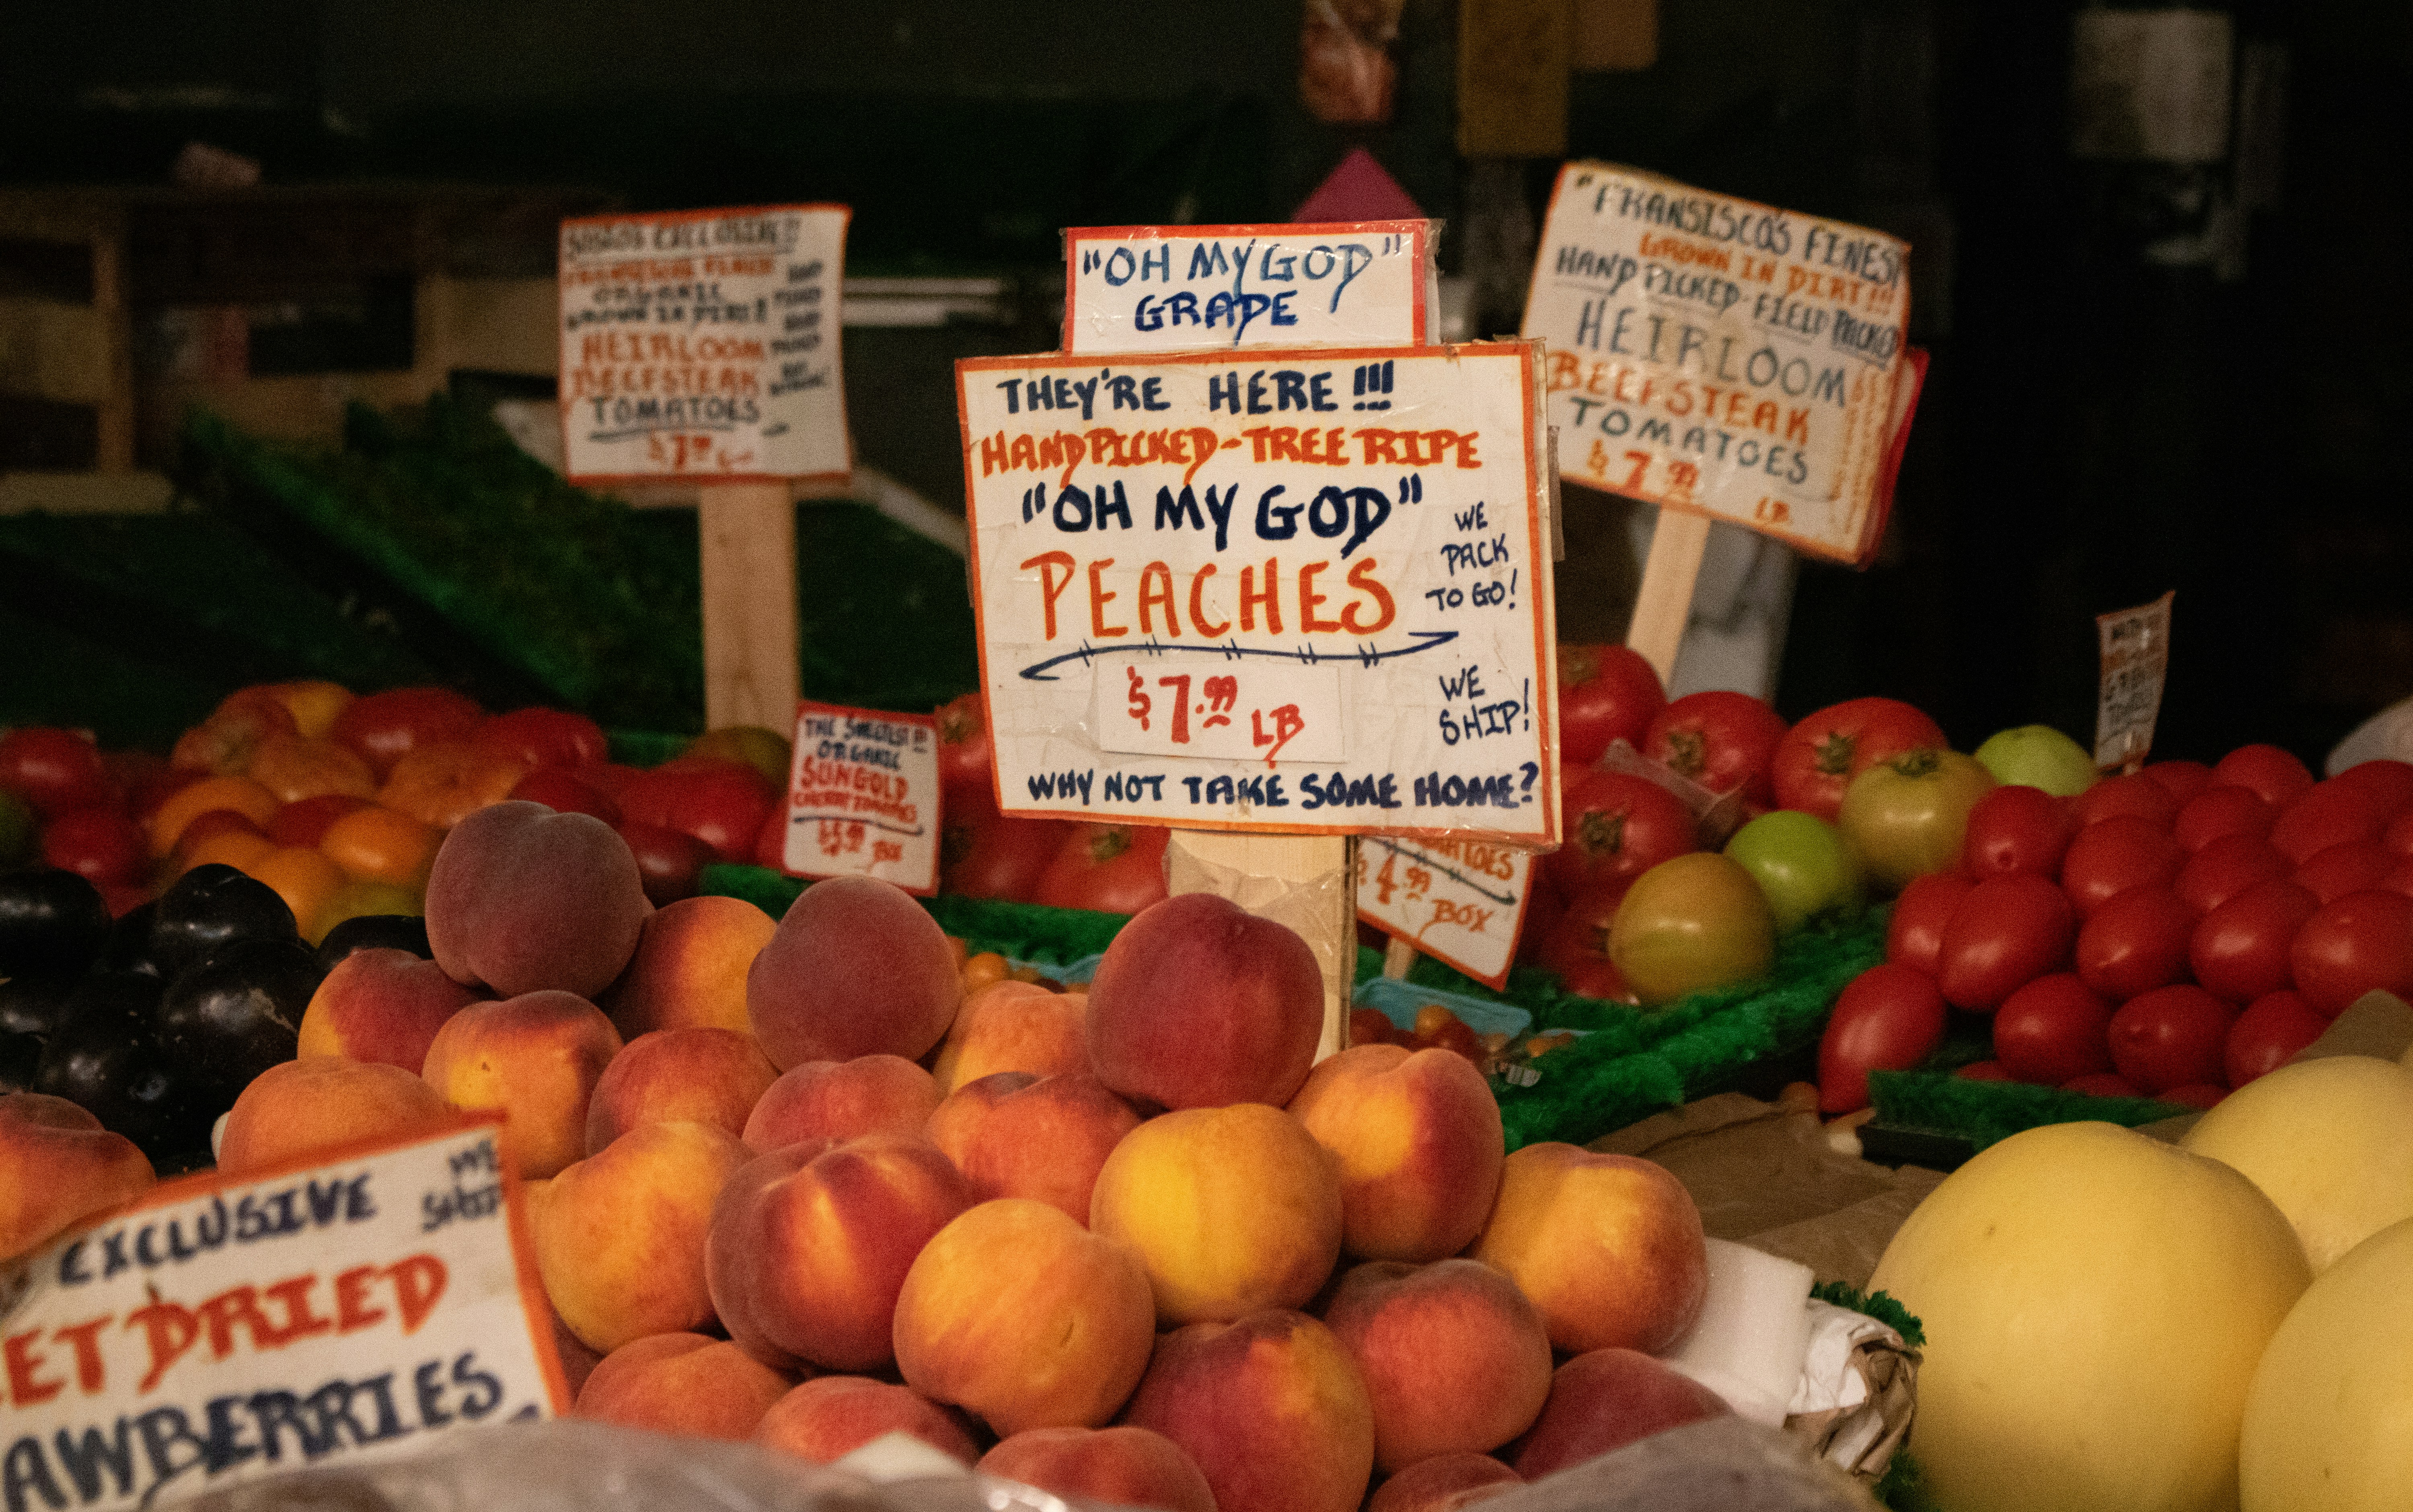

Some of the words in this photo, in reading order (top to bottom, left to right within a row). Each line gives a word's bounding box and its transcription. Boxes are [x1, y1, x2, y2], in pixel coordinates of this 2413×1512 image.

[1083, 242, 1170, 286] "OH
[1188, 239, 1256, 301] MY
[1260, 234, 1401, 314] GOD"
[1556, 244, 1638, 297] HAND
[1741, 255, 1777, 284] IN
[581, 332, 763, 363] HEIRLOOM
[1135, 290, 1299, 348] GRADE
[1576, 297, 1845, 408] HEIRLOOM
[572, 366, 760, 398] BEEFSTEAK
[592, 396, 761, 425] TOMATOES
[996, 368, 1171, 420] THEY'RE
[1209, 369, 1338, 416] HERE
[1547, 349, 1810, 446] BEEFSTEAK
[1570, 396, 1808, 485] TOMATOES
[1022, 480, 1133, 532] "OH
[1155, 483, 1239, 552] MY
[1255, 473, 1422, 559] GOD"
[1454, 500, 1488, 532] WE
[1441, 533, 1509, 577] PACK
[1019, 550, 1397, 641] PEACHES
[1425, 587, 1463, 611] TO
[1472, 568, 1517, 610] GO!
[1126, 666, 1238, 744] $7.99
[1439, 665, 1486, 701] WE
[1439, 678, 1529, 746] SHIP!
[1251, 703, 1305, 769] LB
[1028, 769, 1094, 806] WHY
[1104, 771, 1165, 802] NOT
[1181, 774, 1289, 807] TAKE
[1300, 772, 1402, 809] SOME
[1414, 762, 1539, 809] HOME?
[60, 1171, 377, 1287] EXCLUSIVE
[123, 1253, 449, 1394] DRIED
